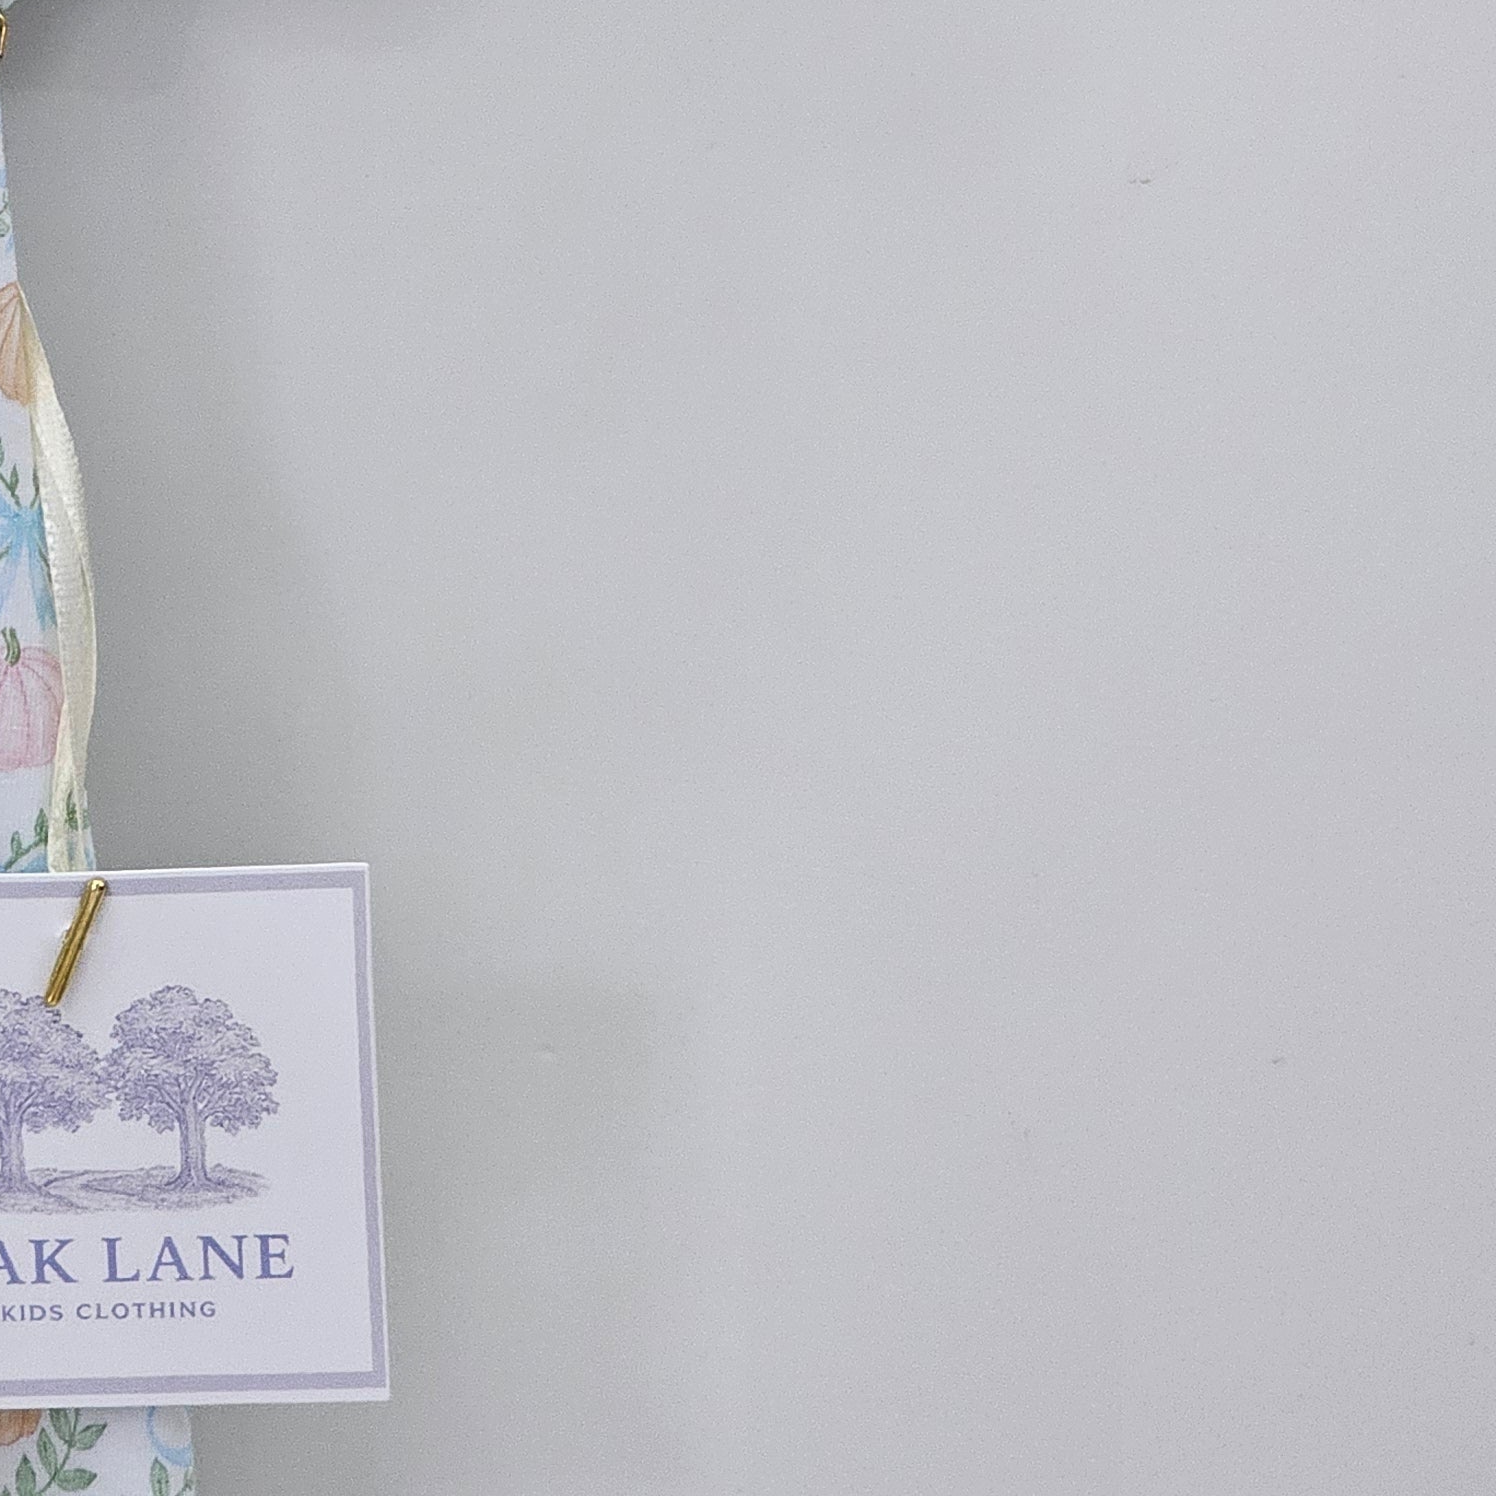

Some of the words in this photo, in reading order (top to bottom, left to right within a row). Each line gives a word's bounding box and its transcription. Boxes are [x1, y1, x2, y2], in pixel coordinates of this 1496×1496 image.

[101, 1233, 295, 1283] LANE
[0, 1303, 65, 1323] KIDS
[75, 1300, 217, 1321] CLOTHING
